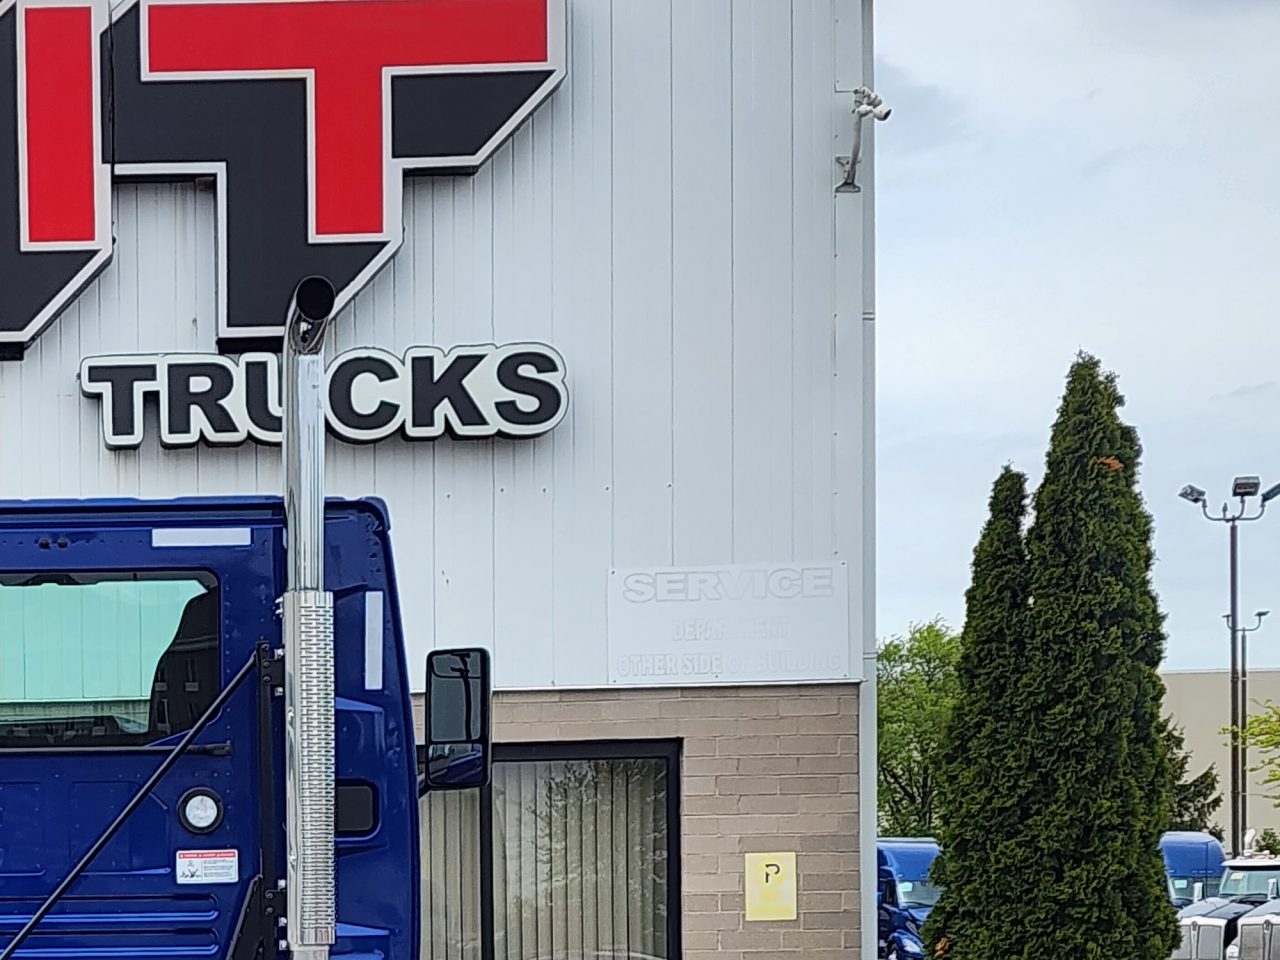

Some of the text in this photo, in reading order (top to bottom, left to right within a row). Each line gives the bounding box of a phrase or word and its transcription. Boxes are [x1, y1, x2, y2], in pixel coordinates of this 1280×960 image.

[622, 567, 834, 604] SERVICE
[617, 653, 679, 678] OTHER
[681, 652, 723, 676] SIDE
